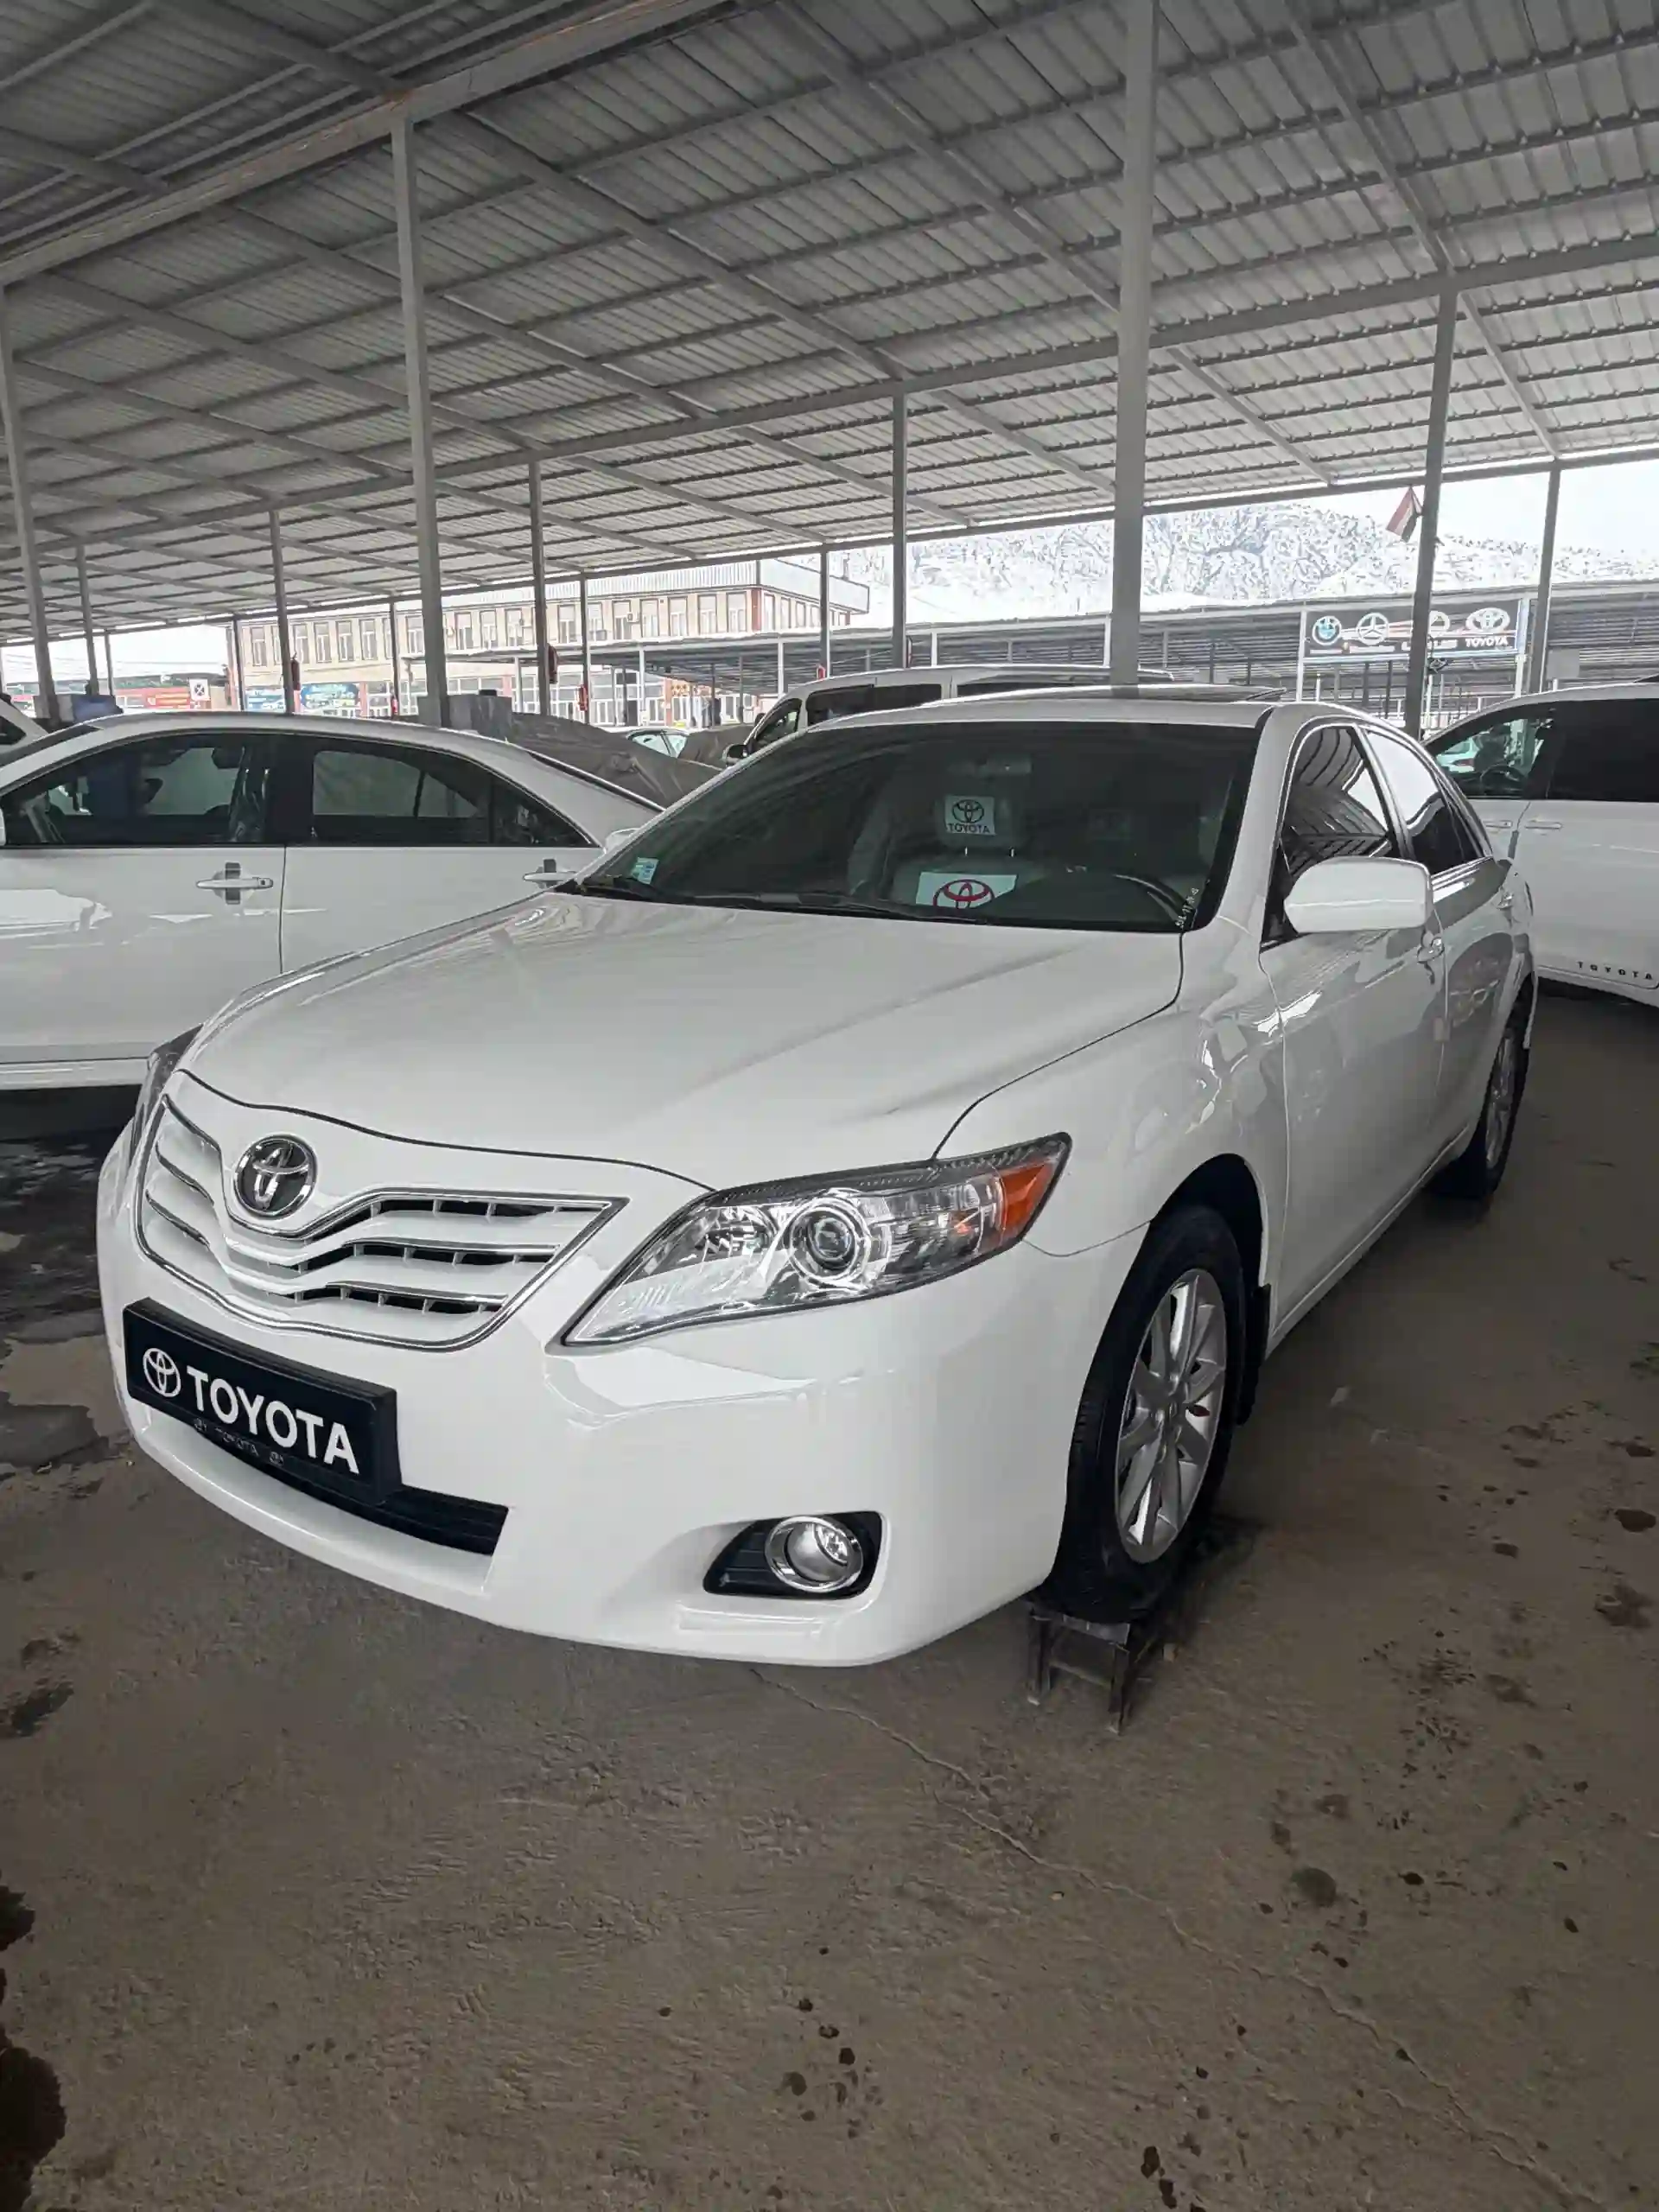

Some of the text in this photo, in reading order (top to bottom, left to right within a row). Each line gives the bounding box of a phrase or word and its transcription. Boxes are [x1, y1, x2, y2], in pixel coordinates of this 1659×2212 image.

[1465, 638, 1508, 647] TOYOTA
[949, 823, 990, 834] TOYOTA
[1577, 961, 1652, 980] TOYOTA
[187, 1366, 359, 1474] TOYOTA
